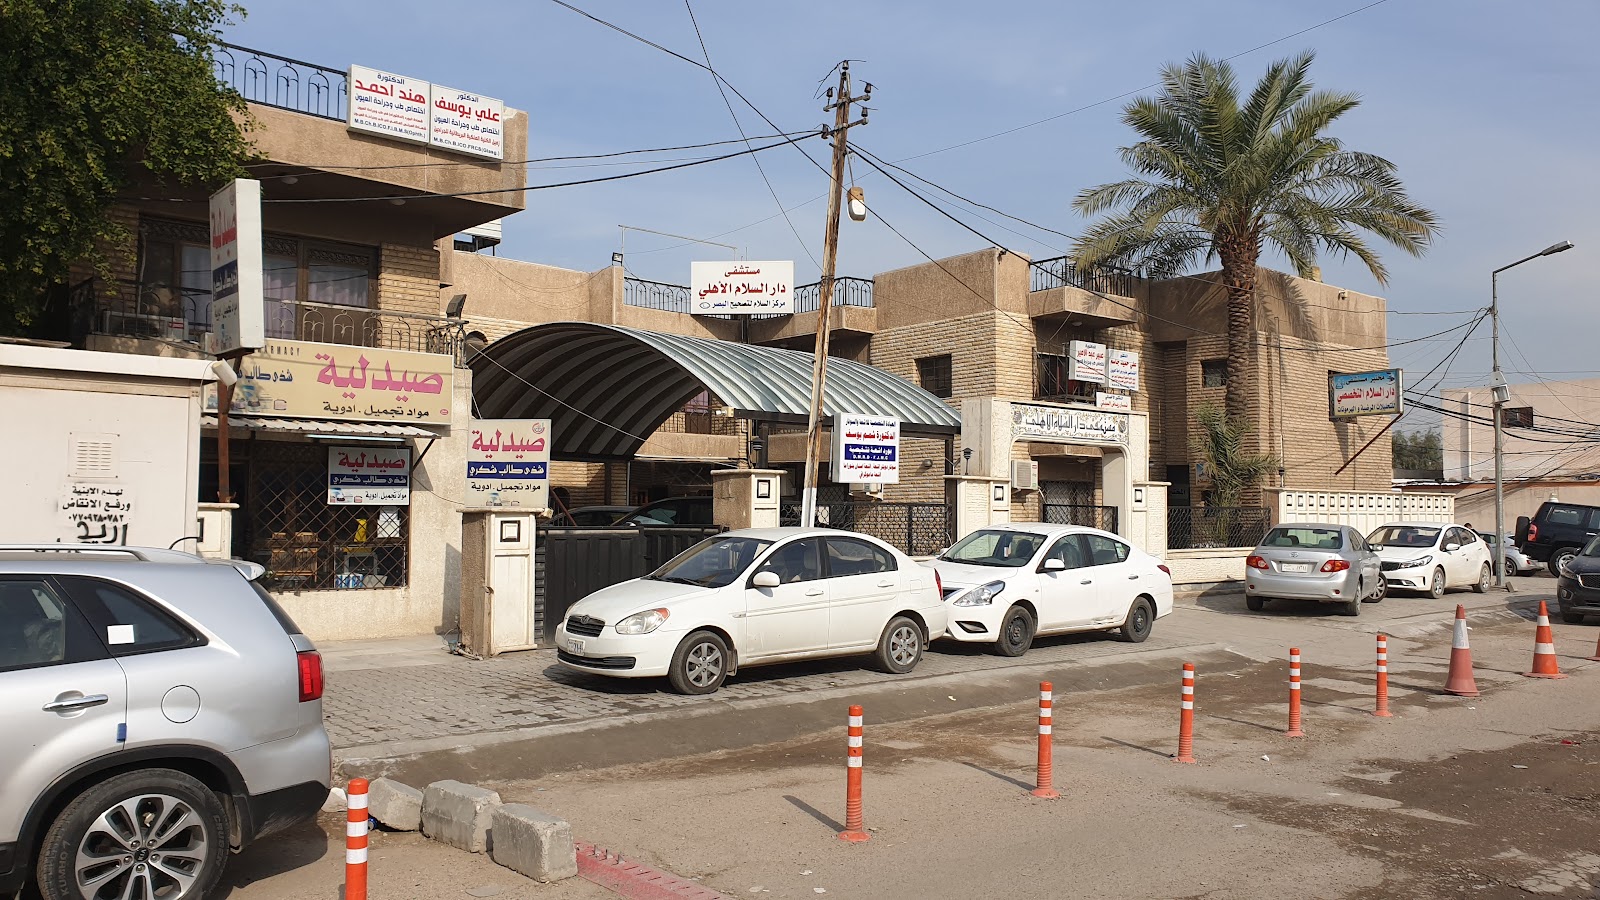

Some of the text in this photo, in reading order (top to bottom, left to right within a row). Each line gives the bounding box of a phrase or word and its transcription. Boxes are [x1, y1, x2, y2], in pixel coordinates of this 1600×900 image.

[377, 73, 404, 85] الدكتورة
[355, 79, 426, 104] هند احمد
[457, 93, 479, 103] الدكتور
[355, 93, 425, 115] اختصاص طب وجراحة العيون
[434, 96, 500, 122] علي يوسف
[434, 114, 500, 136] اختصاص طب وجراحة العيون
[724, 265, 761, 278] مستشفى
[699, 280, 786, 300] دار السلام الأهلي
[712, 300, 786, 309] مركز السلام لتصحيح البصر
[259, 345, 300, 357] ARMACY
[245, 365, 271, 383] طالب
[315, 353, 444, 403] صيدلية
[1366, 386, 1385, 400] السلام
[1385, 387, 1395, 399] دار
[323, 401, 356, 415] ادوية
[364, 405, 403, 418] تجميل
[407, 407, 430, 419] مواد
[845, 428, 862, 441] يوسف
[472, 428, 546, 459] صيدلية
[338, 451, 406, 473] صيدلية
[469, 464, 545, 477] شذى طالب شكري
[333, 475, 361, 485] شكري
[362, 475, 387, 485] طالب
[72, 485, 99, 497] الابنية
[471, 481, 541, 493] مواد تجميل ادوية
[380, 491, 397, 501] تجميل
[62, 497, 101, 510] الانقاض
[58, 852, 70, 896] KUMHO
